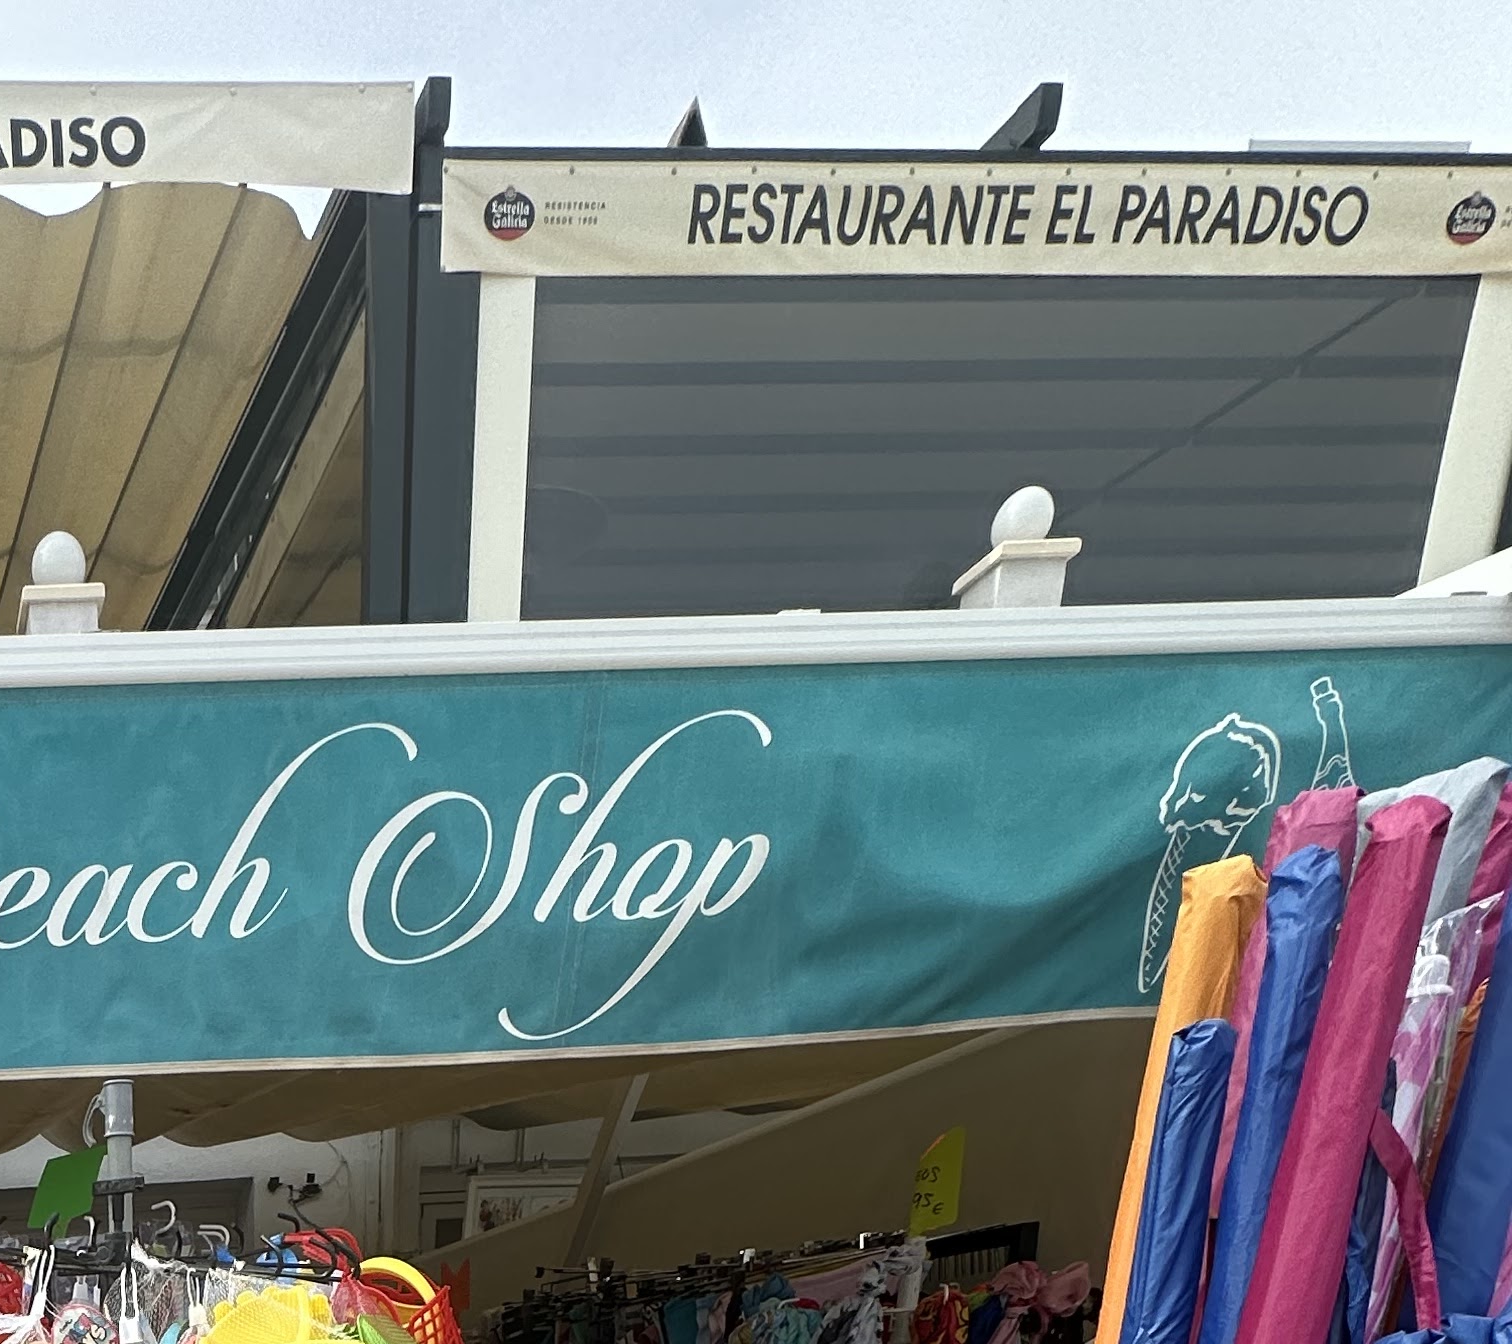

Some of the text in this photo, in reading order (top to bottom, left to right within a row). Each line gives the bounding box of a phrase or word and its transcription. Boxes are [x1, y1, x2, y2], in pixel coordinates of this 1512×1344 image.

[491, 200, 530, 216] Estrella
[544, 201, 606, 211] RESISTENCIA
[491, 213, 528, 230] Galicia
[688, 183, 1370, 247] RESTAURANTE EL PARADISO
[346, 709, 773, 1041] Shop
